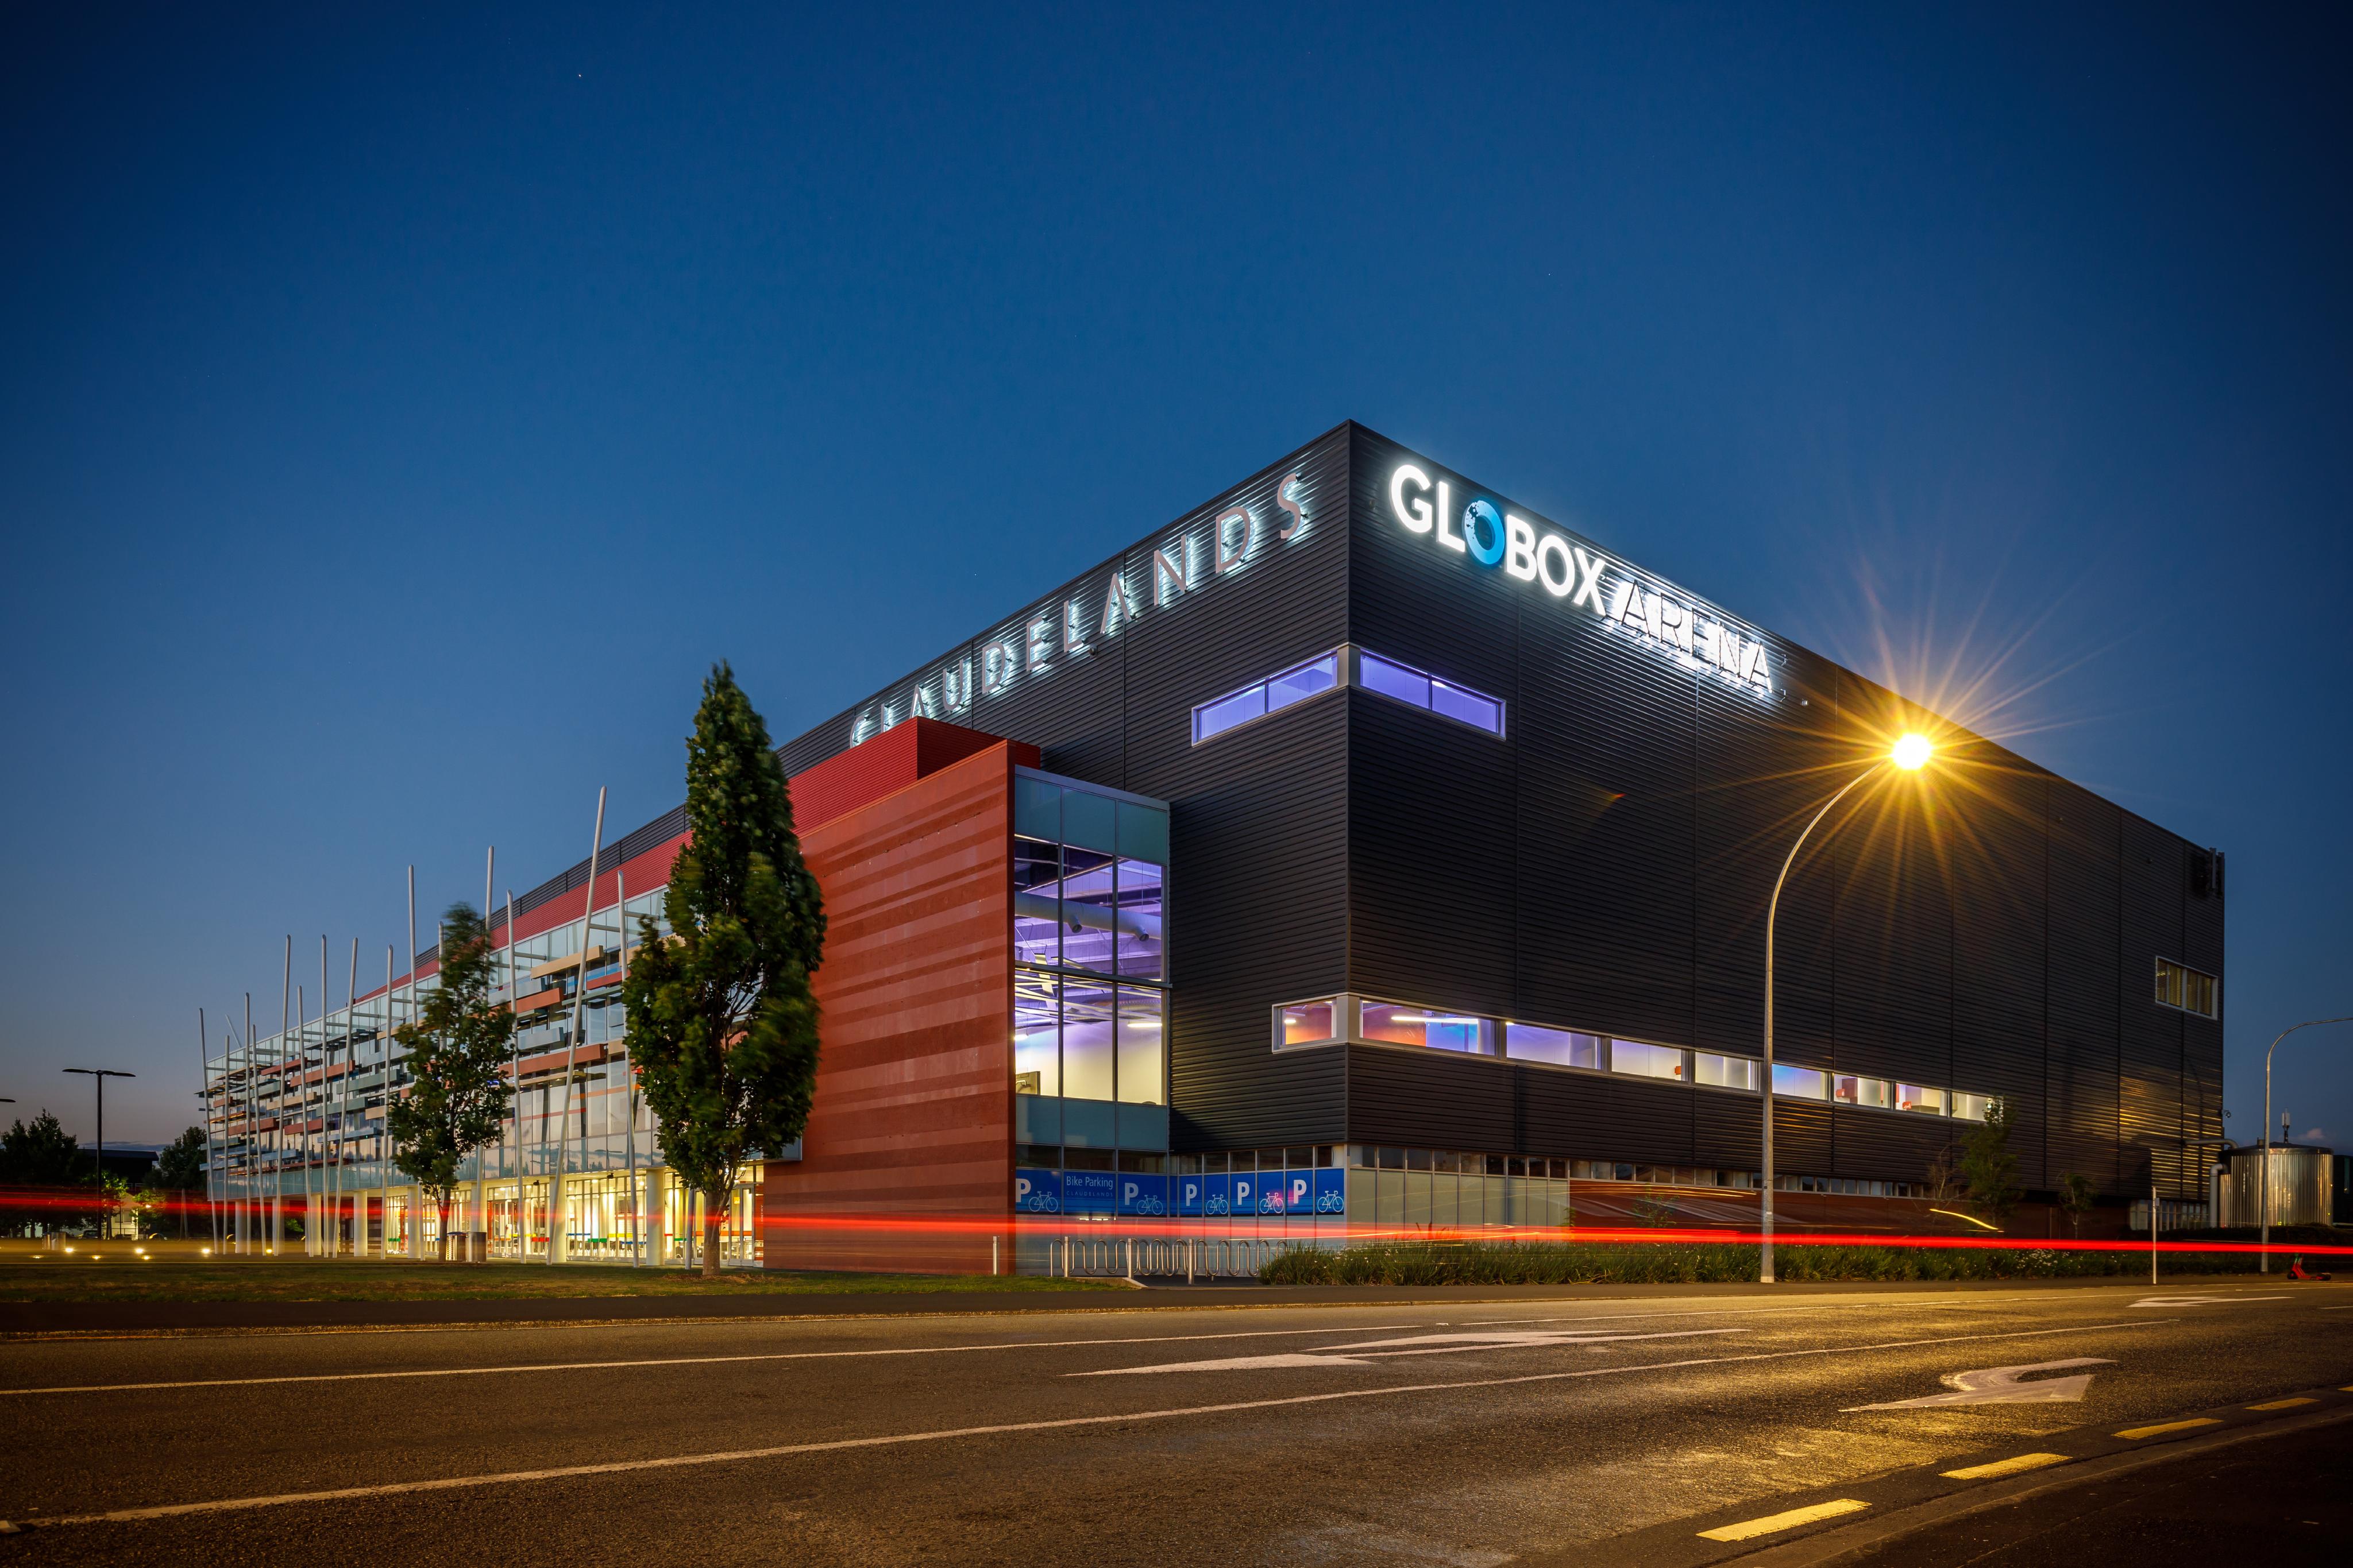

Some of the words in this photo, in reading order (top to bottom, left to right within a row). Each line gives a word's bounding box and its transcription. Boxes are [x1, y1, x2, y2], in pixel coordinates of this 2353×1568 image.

[1389, 464, 1607, 616] GLOBOX
[1621, 579, 1773, 694] ARENA
[1016, 1178, 1031, 1203] P
[1066, 1176, 1083, 1186] Bike
[1085, 1176, 1113, 1190] Parking
[1125, 1183, 1139, 1206] P
[1186, 1184, 1197, 1206] P
[1237, 1182, 1250, 1206] P
[1294, 1179, 1307, 1204] P
